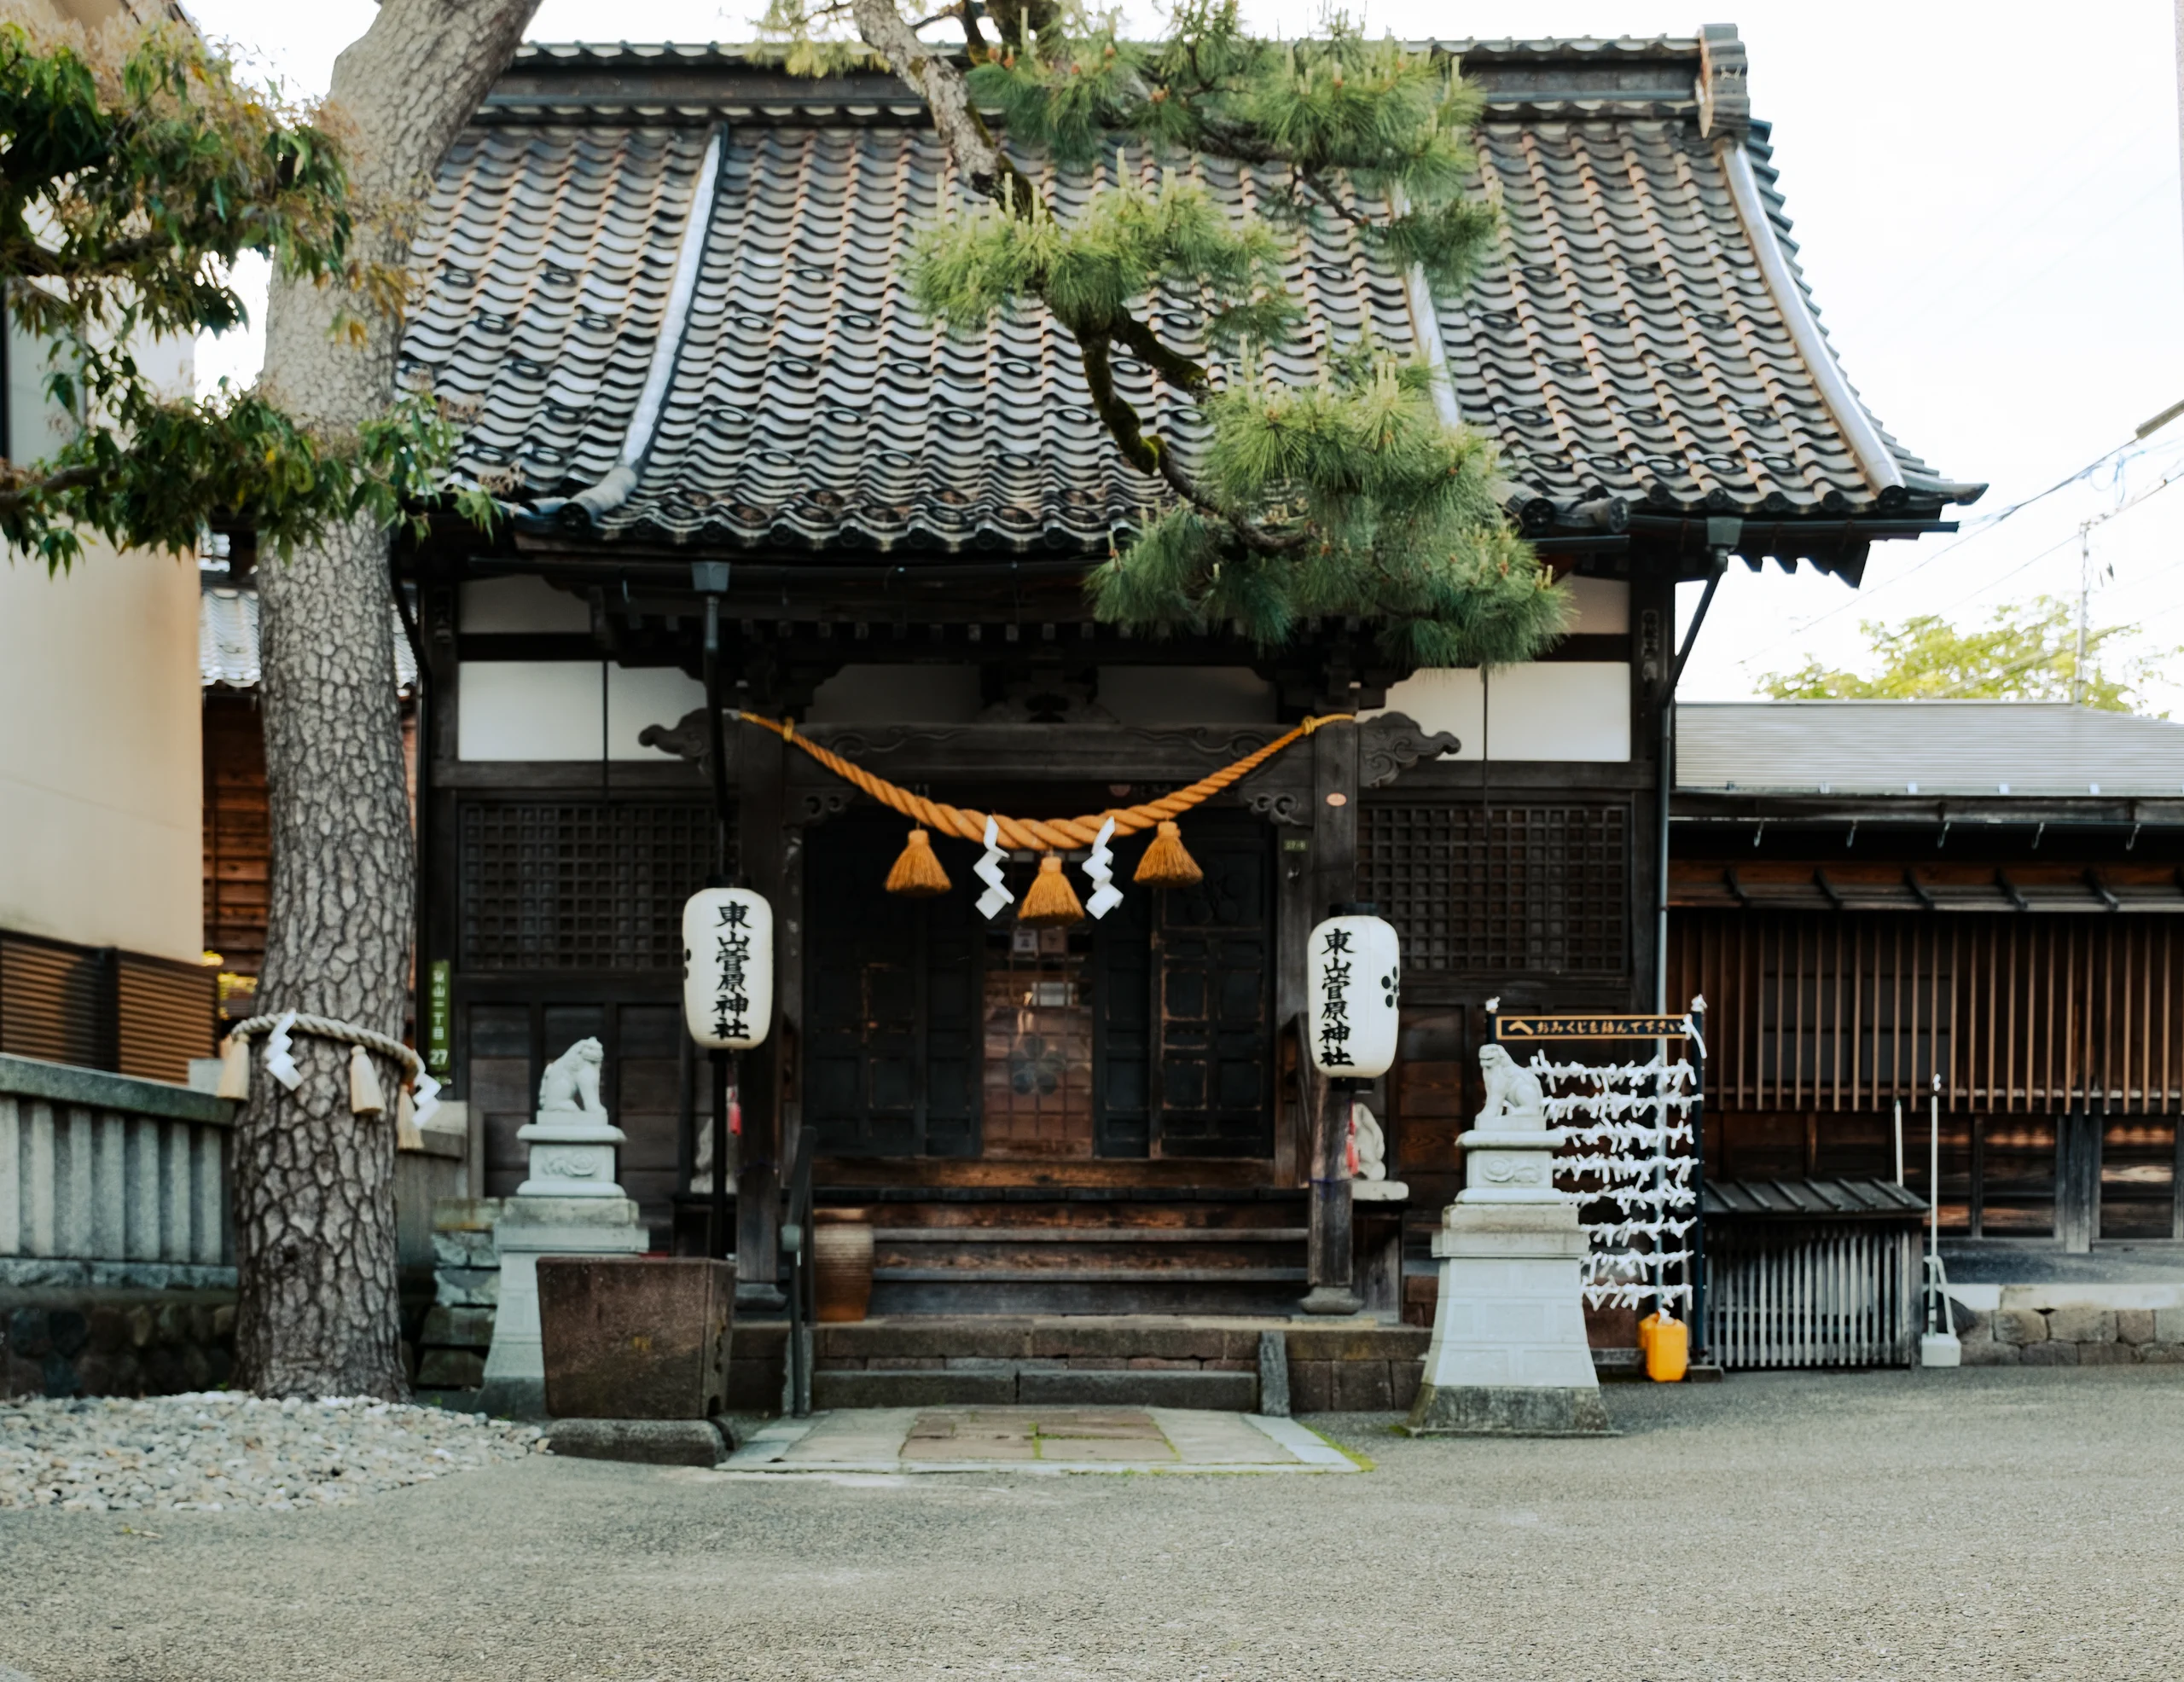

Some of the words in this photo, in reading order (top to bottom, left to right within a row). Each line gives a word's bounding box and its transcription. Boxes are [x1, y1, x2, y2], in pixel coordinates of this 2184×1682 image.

[712, 901, 752, 1041] 東山菅原神社
[1318, 928, 1356, 1067] 東山菅原神社
[429, 1048, 448, 1065] 27
